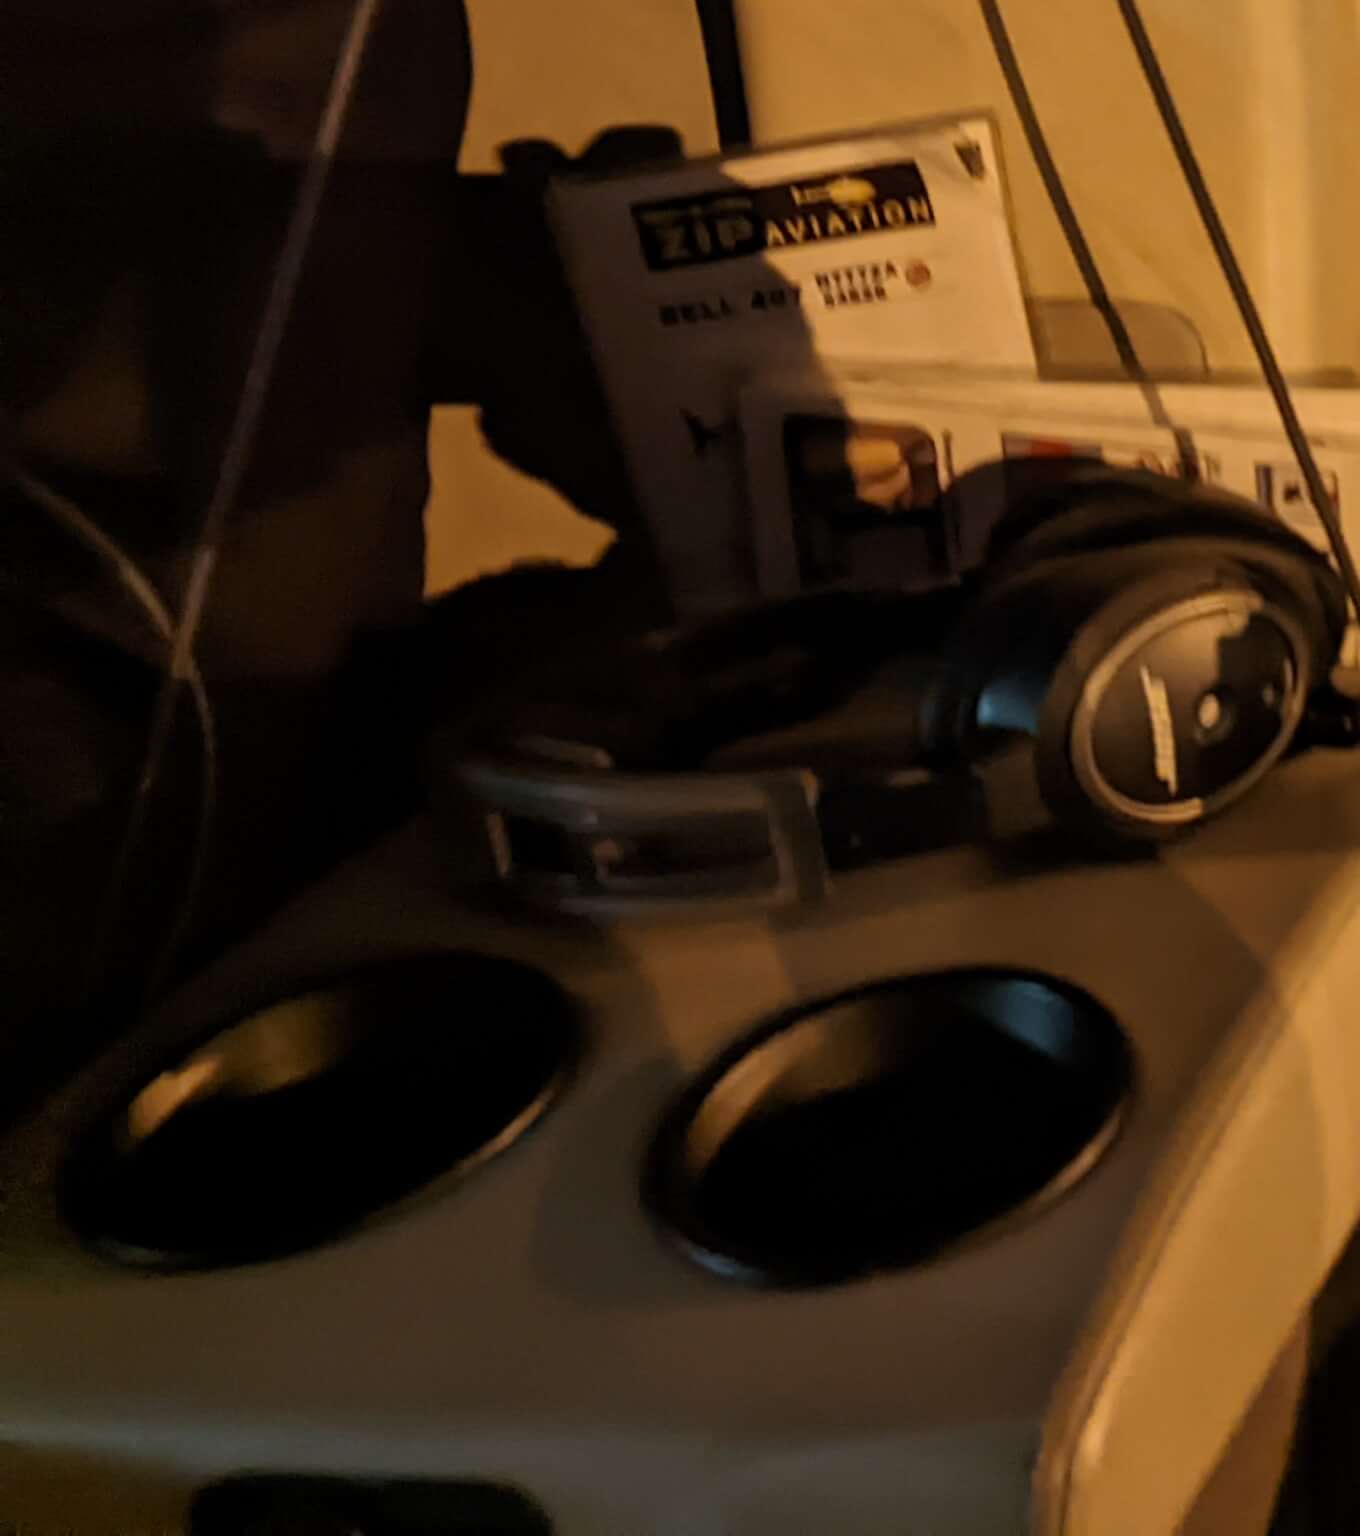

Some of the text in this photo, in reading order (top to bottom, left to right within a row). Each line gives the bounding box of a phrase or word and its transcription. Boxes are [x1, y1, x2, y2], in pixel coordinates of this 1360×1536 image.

[656, 195, 937, 262] ZIP AVIATION
[658, 297, 732, 327] BELL
